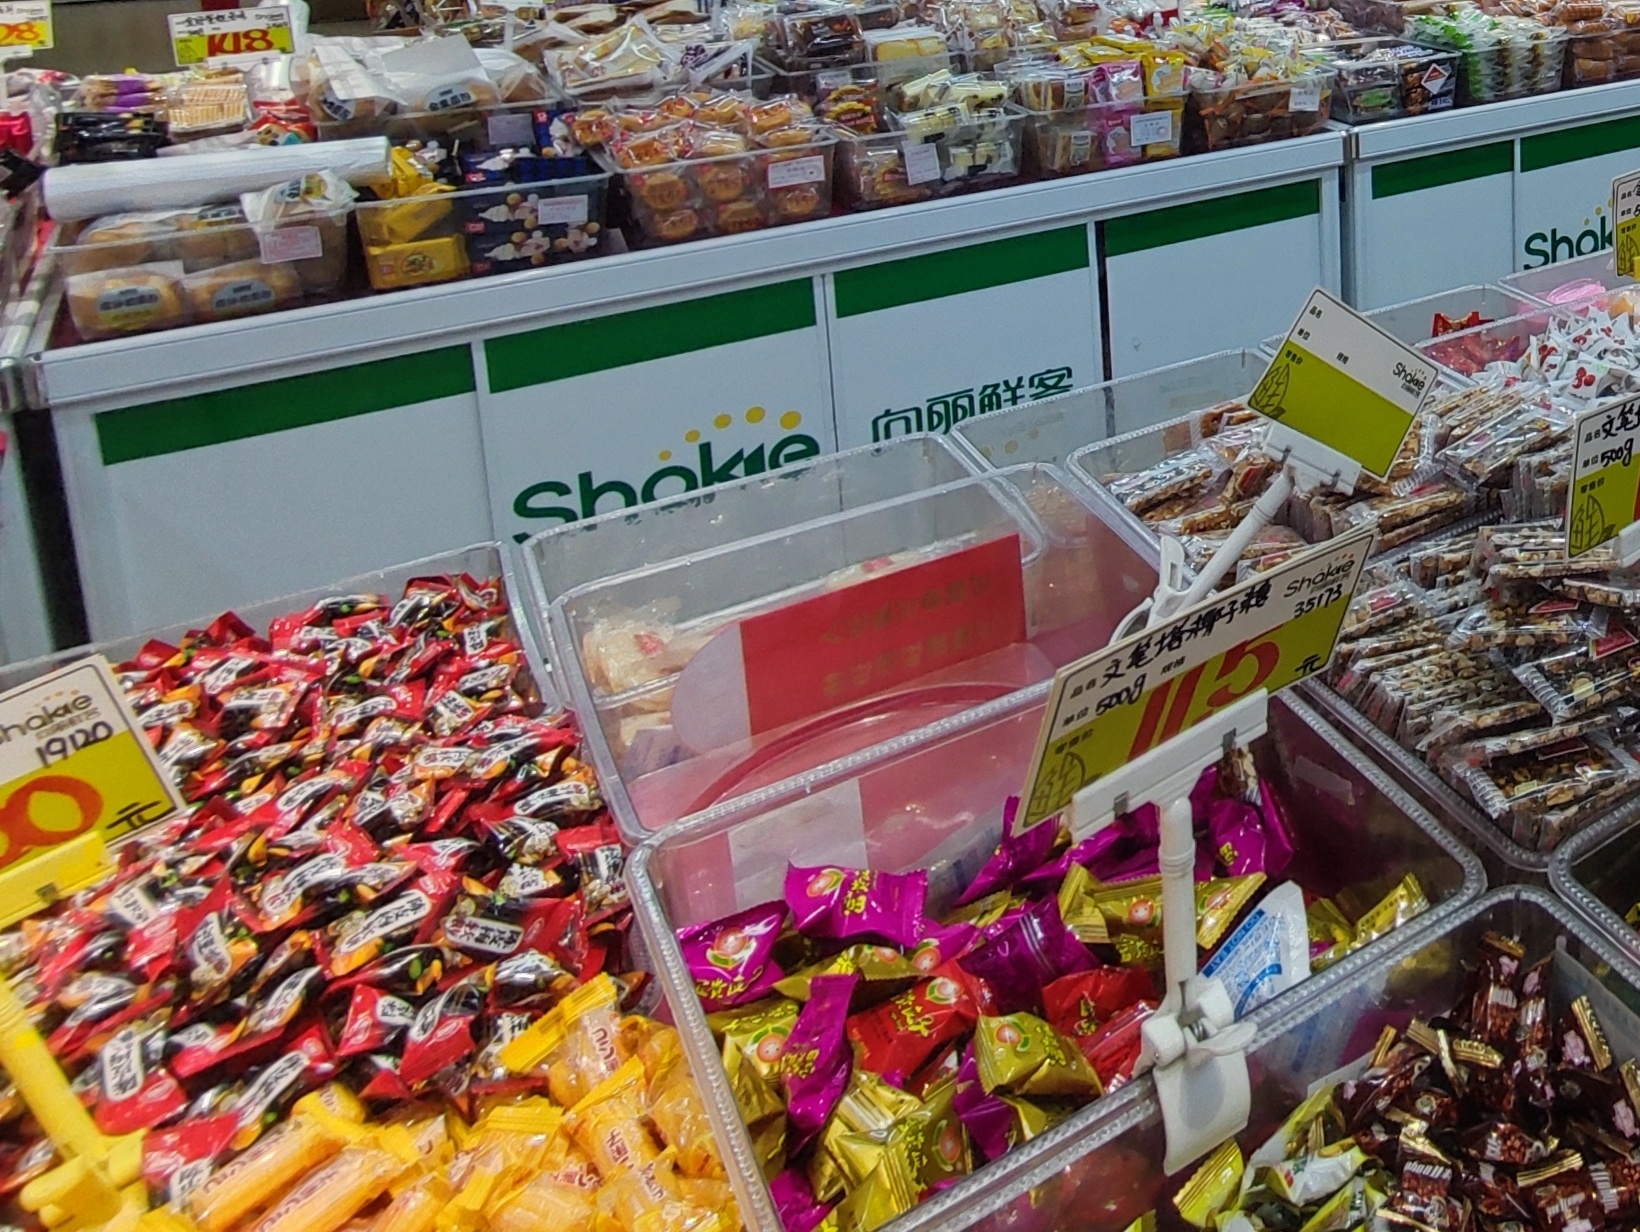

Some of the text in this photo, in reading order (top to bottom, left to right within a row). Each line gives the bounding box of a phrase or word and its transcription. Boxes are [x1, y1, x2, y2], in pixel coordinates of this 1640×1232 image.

[1582, 454, 1599, 468] 单位
[1600, 437, 1634, 468] 500g
[1584, 429, 1601, 443] 品名
[1294, 584, 1343, 619] 35173
[1070, 578, 1271, 700] 品名 文笔塔椰子糖
[1295, 653, 1326, 675] 元
[1062, 706, 1089, 728] 单位
[1096, 674, 1148, 717] 500g
[106, 801, 162, 830] 元
[1207, 913, 1260, 970] DO NOT EAT
